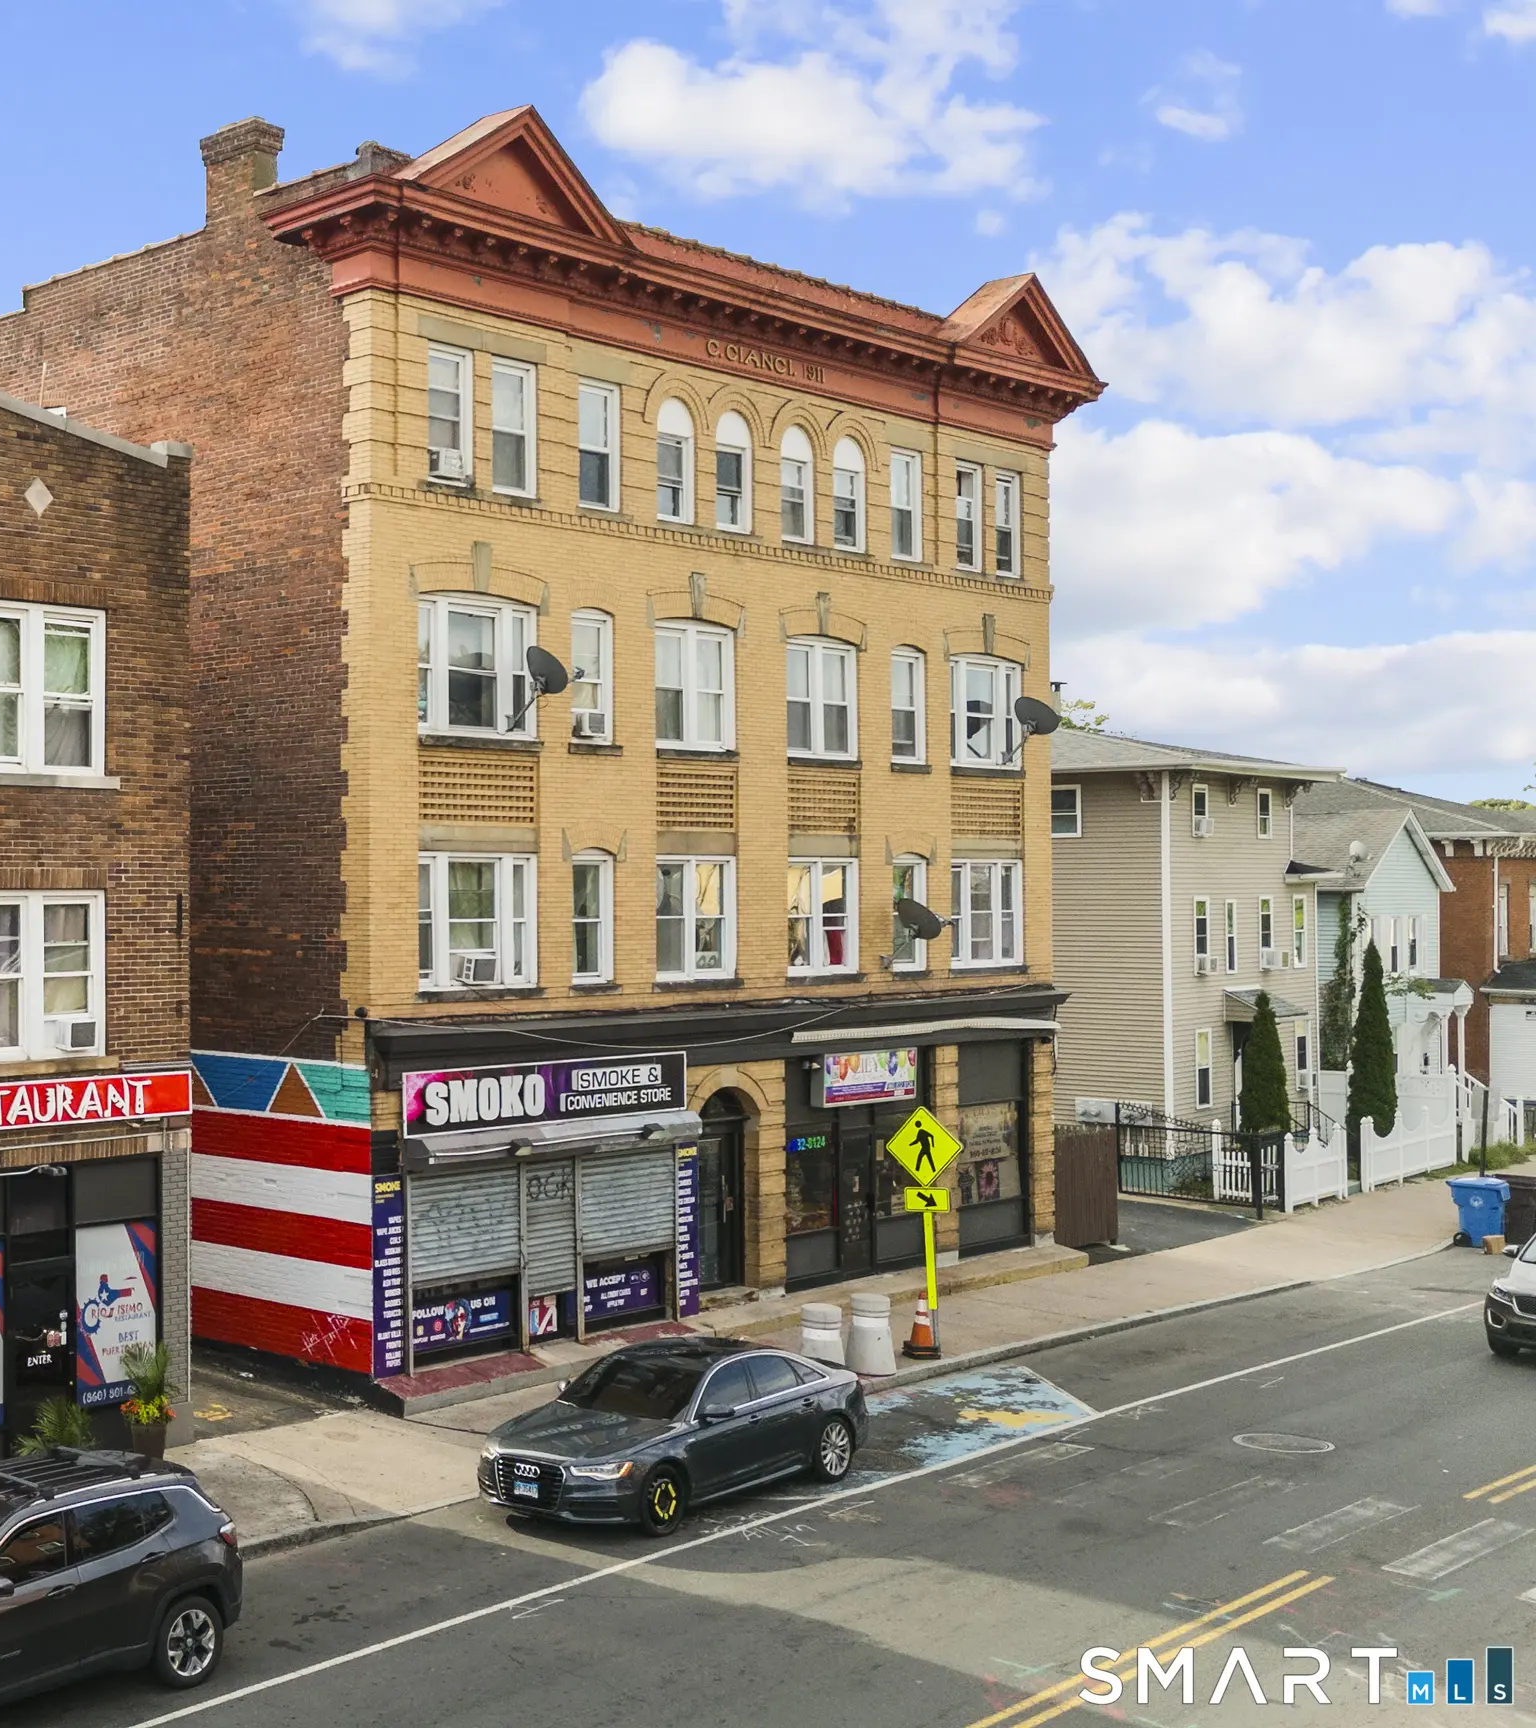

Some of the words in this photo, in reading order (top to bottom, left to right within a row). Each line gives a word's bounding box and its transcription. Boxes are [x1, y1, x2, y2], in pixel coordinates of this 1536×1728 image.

[580, 1068, 641, 1090] SMOKE
[648, 1067, 660, 1083] &
[425, 1073, 545, 1126] SMOKO
[567, 1090, 639, 1111] CONVENIENCE
[640, 1087, 672, 1104] STORE
[375, 1181, 401, 1193] SMOKE
[586, 1279, 598, 1289] WE
[599, 1274, 626, 1287] ACCEPT
[412, 1306, 445, 1320] FOLLOW
[470, 1299, 482, 1309] US
[483, 1296, 496, 1306] ON
[114, 1311, 152, 1322] RESTAURANT
[118, 1330, 140, 1343] BEST
[27, 1354, 53, 1367] ENTER
[82, 1388, 107, 1405] (860)
